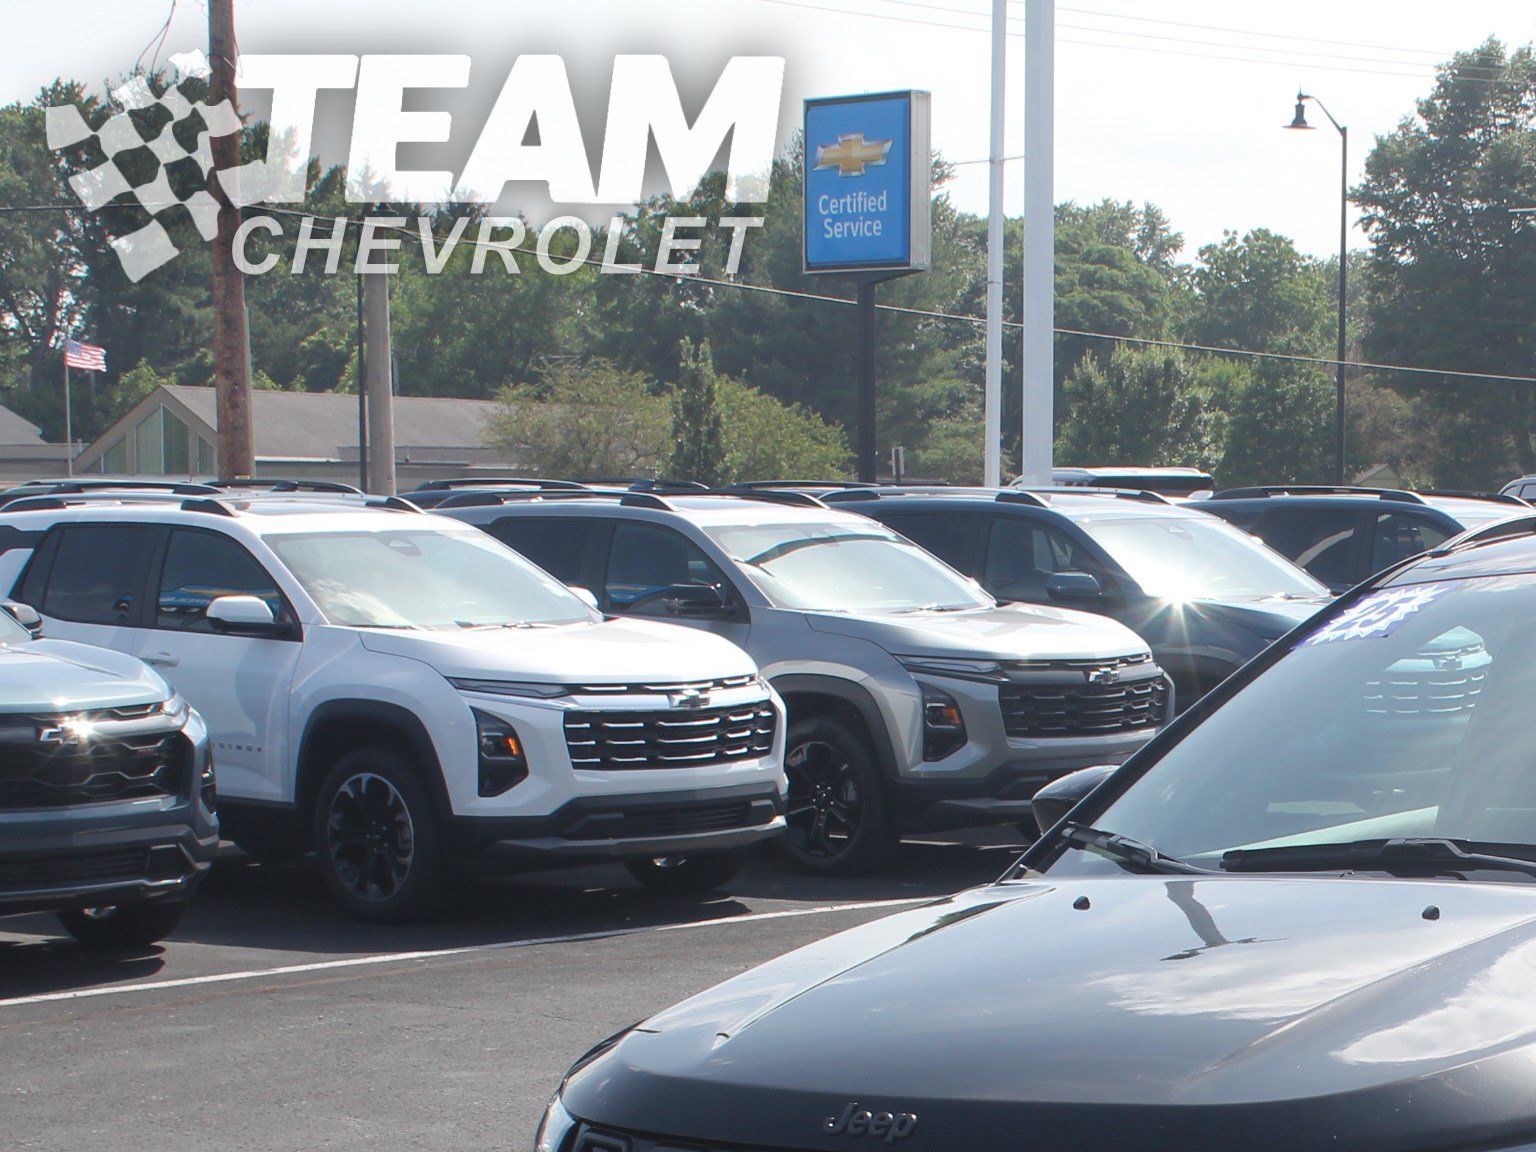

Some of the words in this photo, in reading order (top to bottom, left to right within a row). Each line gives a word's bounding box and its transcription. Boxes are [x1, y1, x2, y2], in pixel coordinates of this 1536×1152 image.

[818, 190, 887, 215] Certified
[823, 216, 883, 239] Service
[823, 1102, 918, 1143] Jeep
